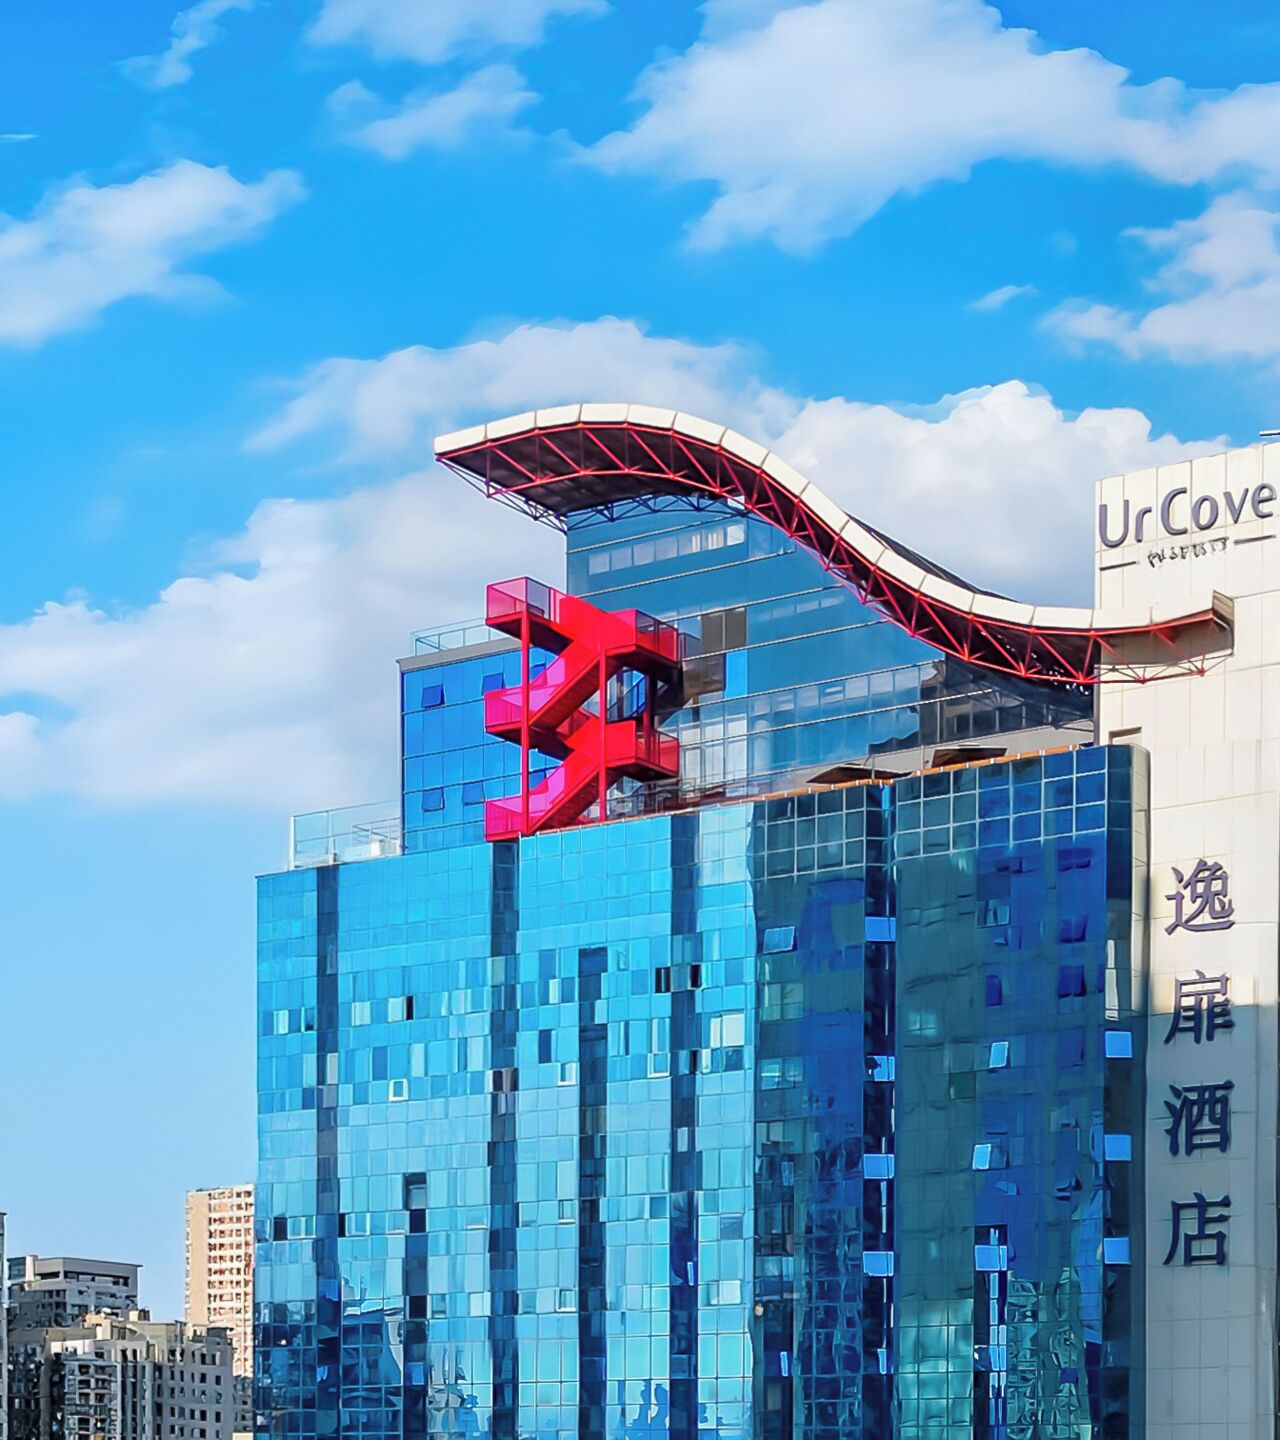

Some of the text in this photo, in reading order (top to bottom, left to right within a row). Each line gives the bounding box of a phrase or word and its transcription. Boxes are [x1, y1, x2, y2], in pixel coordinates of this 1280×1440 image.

[1098, 482, 1277, 549] UrCove
[1163, 857, 1236, 1267] 逸扉酒店
